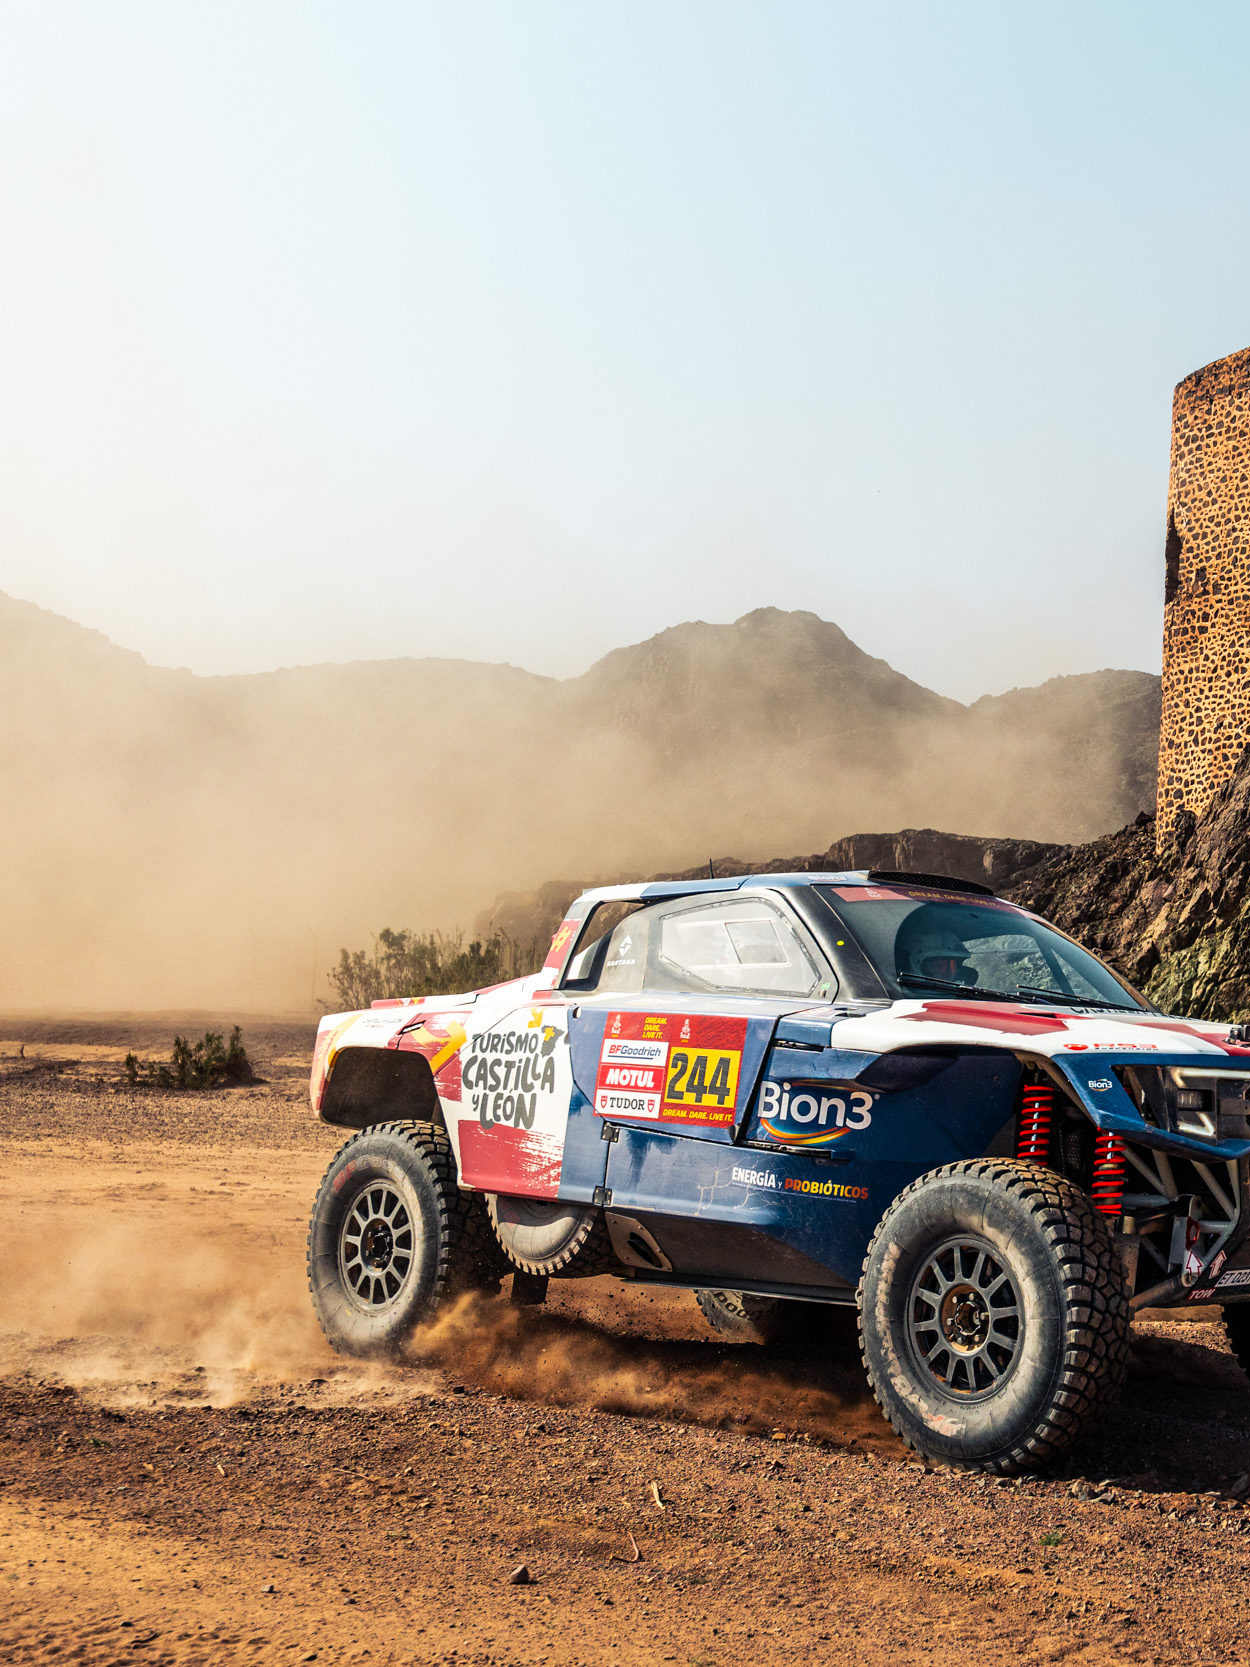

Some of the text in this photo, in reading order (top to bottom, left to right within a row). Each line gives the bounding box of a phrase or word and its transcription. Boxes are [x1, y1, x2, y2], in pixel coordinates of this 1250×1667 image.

[608, 1044, 661, 1057] BFGoodrich
[605, 1068, 655, 1088] MOTUL
[666, 1052, 731, 1106] 244
[1088, 1080, 1113, 1088] Bion3
[480, 1088, 537, 1130] LEÓN
[609, 1097, 645, 1111] TUDOR
[662, 1108, 688, 1118] DREAM.
[688, 1110, 708, 1119] DARE.
[708, 1112, 725, 1121] LIVE
[784, 1178, 869, 1200] PROBIÓTICOS
[1218, 1272, 1233, 1285] ET
[1189, 1288, 1216, 1300] TOW
